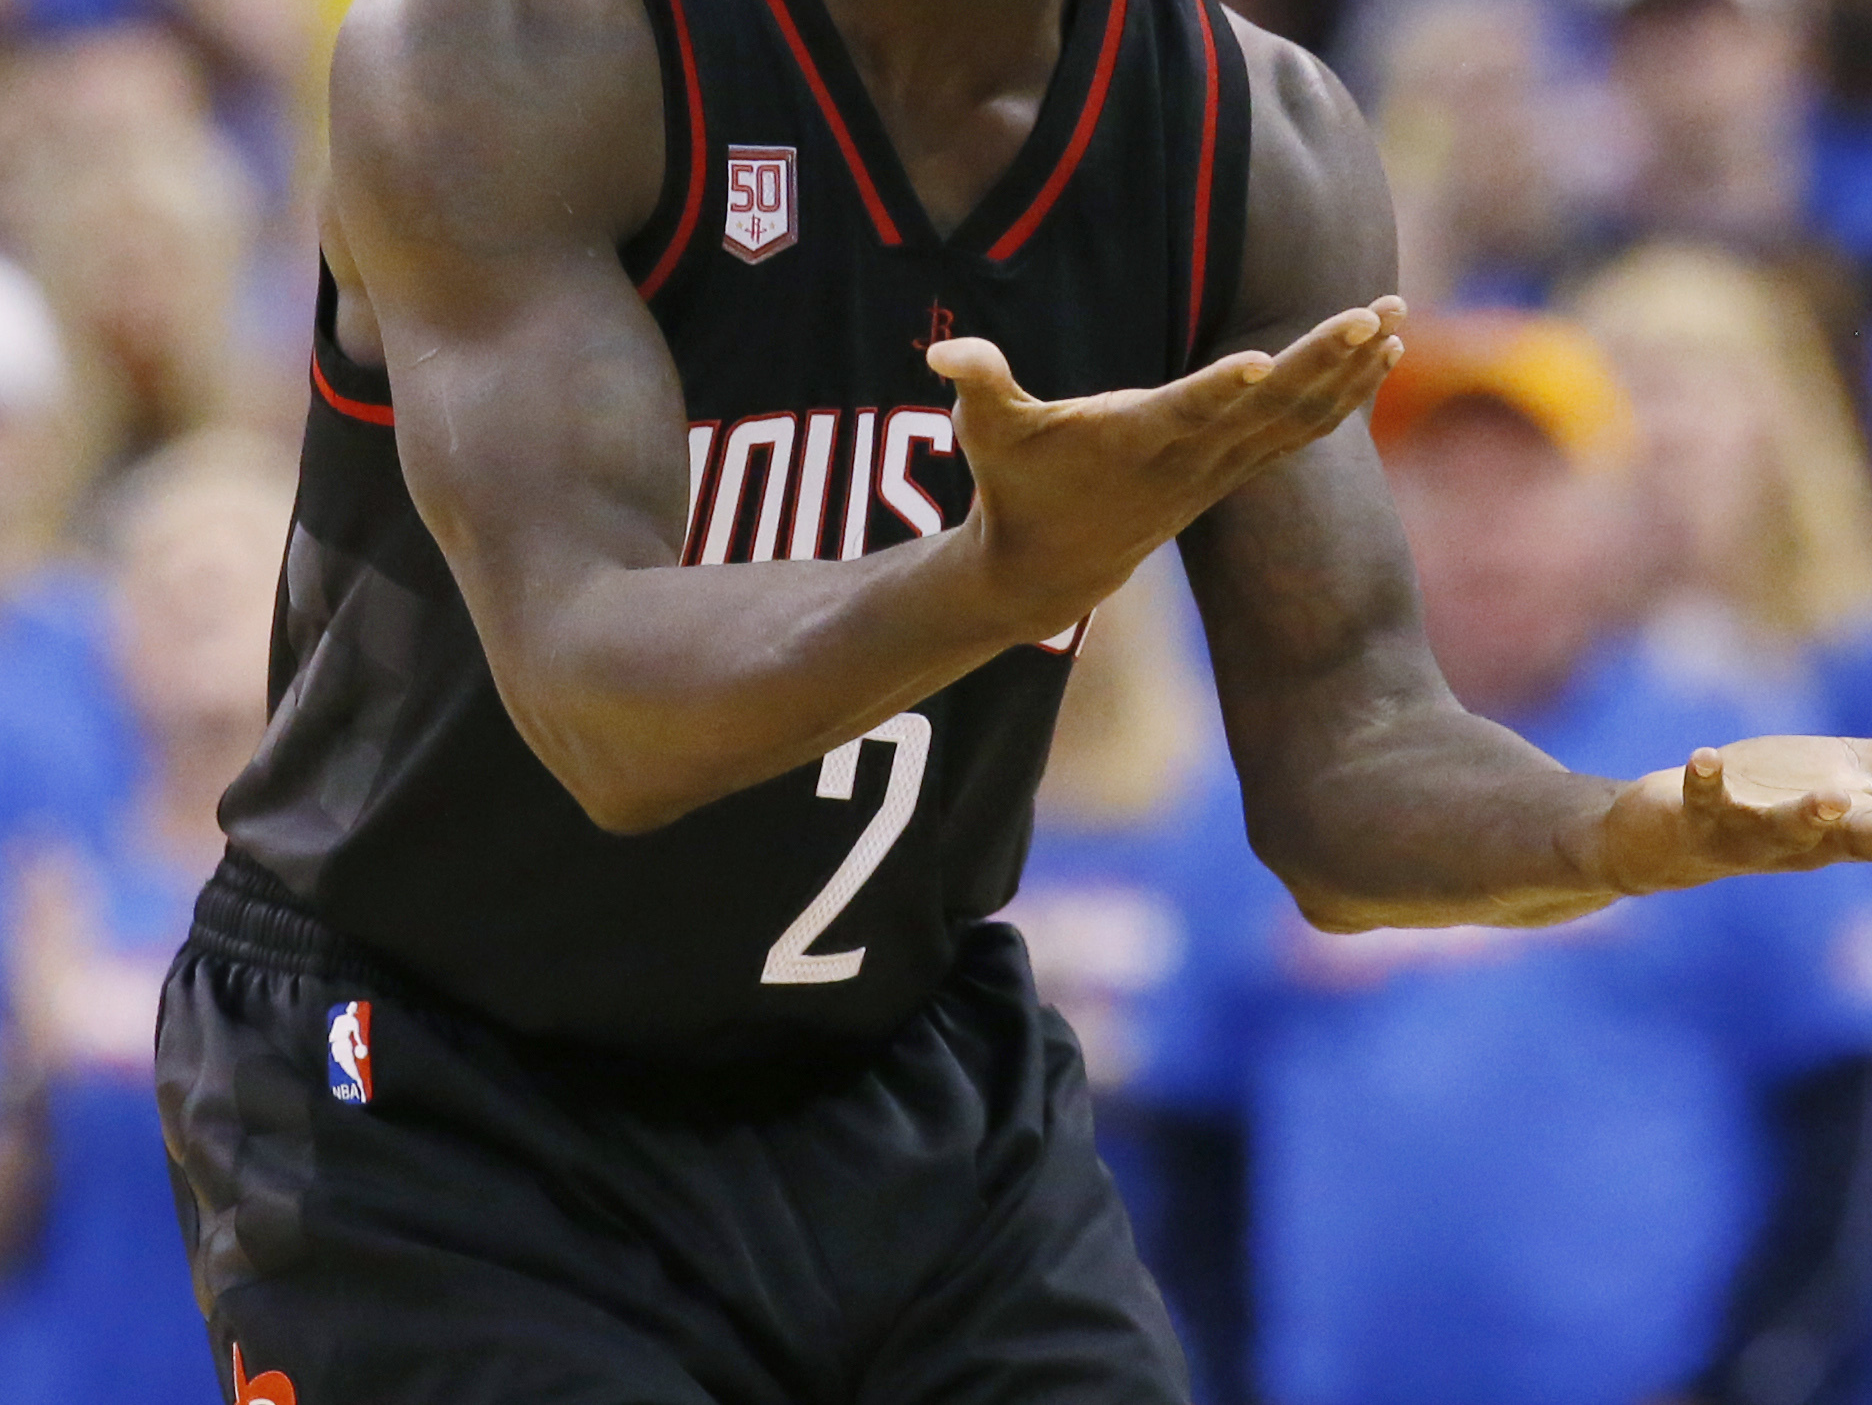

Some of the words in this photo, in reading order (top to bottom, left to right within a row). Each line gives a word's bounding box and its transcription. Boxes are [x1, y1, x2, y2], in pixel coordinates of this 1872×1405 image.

[730, 164, 781, 212] 50
[760, 711, 933, 985] 2
[332, 1083, 360, 1100] NBA
